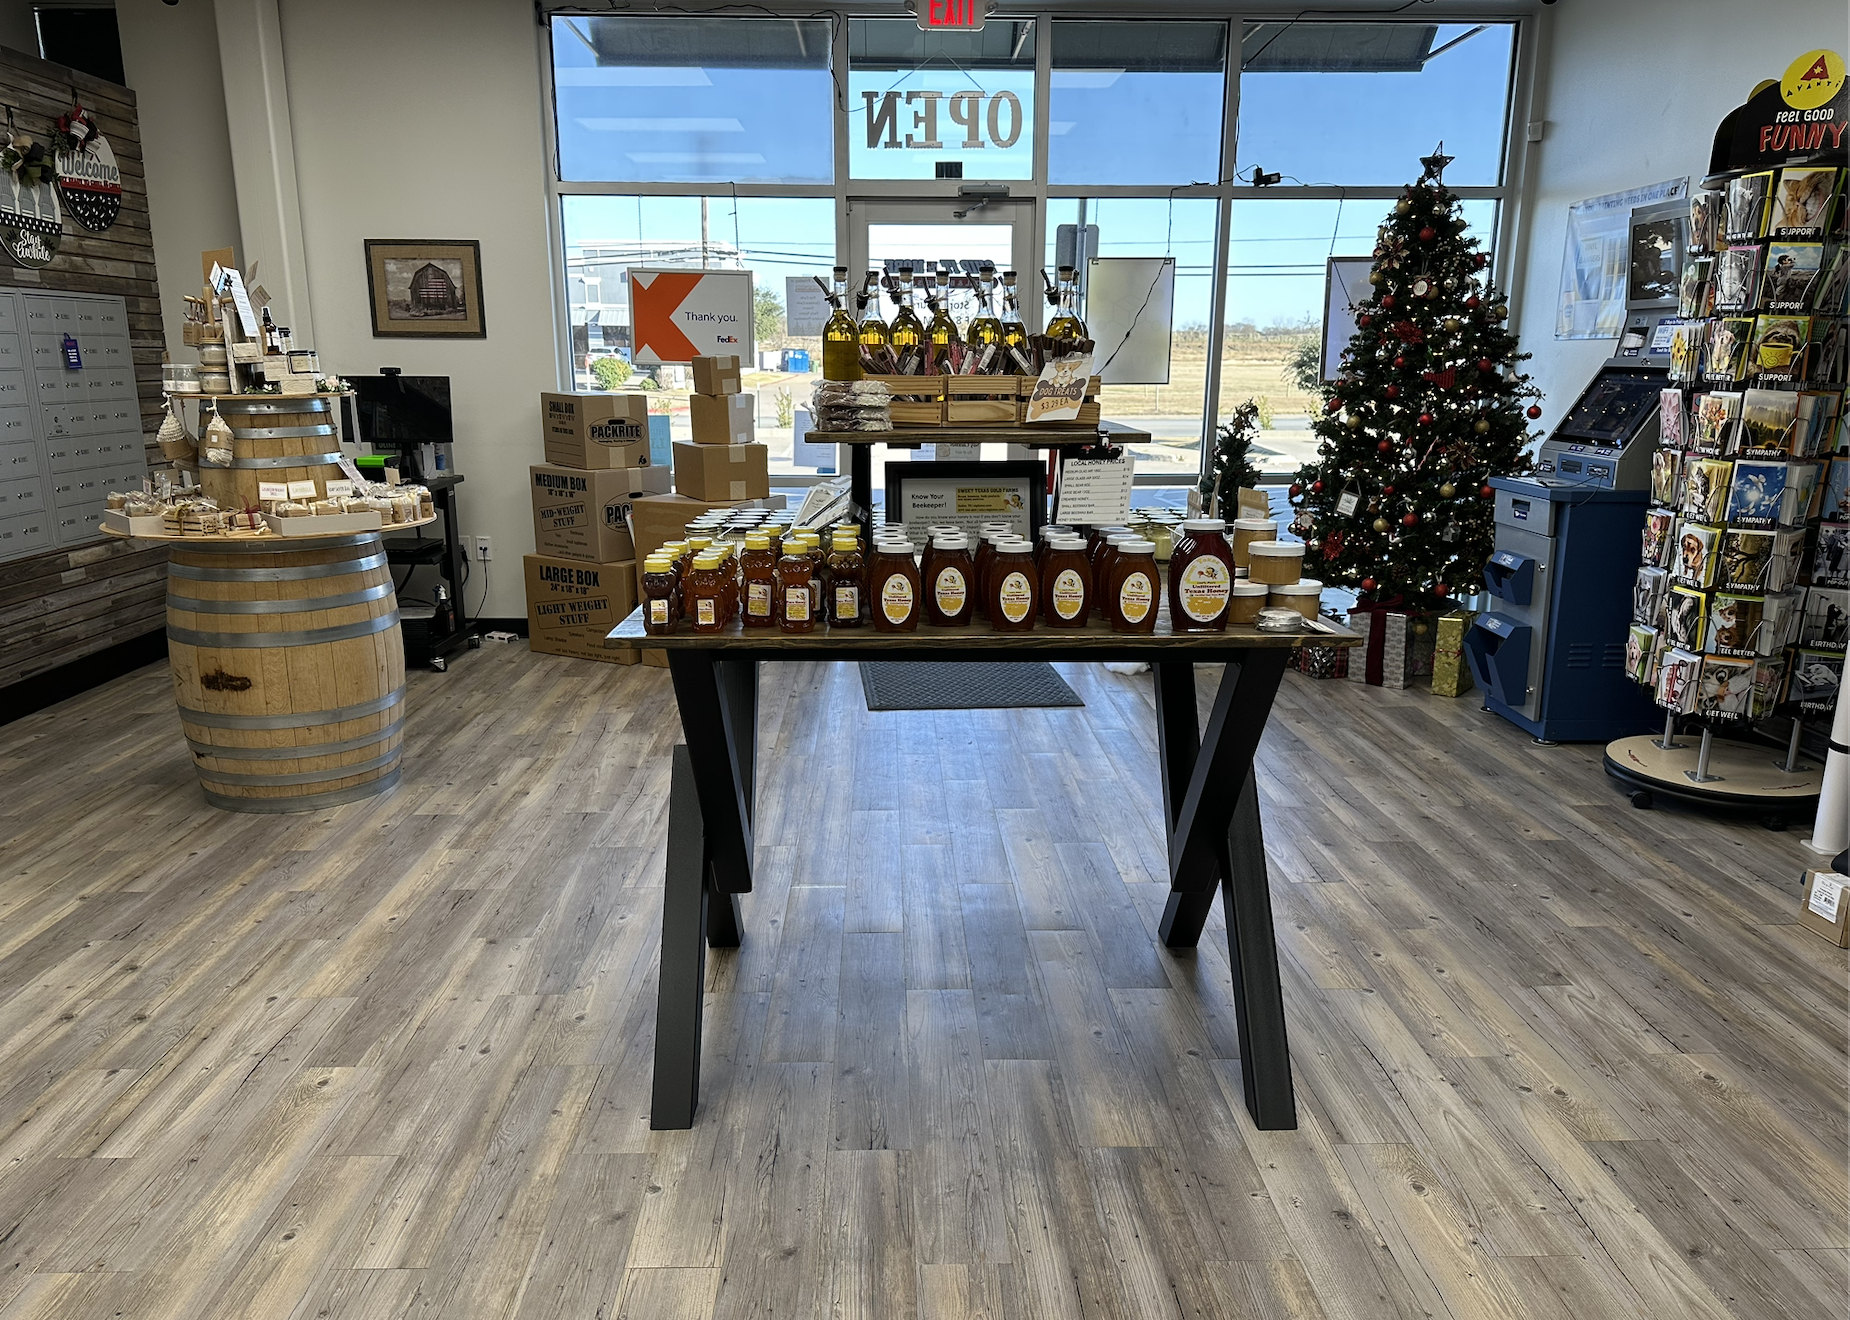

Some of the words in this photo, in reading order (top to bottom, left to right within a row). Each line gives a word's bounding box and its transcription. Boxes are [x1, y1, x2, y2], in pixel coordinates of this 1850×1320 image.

[929, 0, 974, 26] EXIT
[1786, 80, 1841, 97] AVANTI
[1804, 108, 1834, 122] GOOD
[1759, 121, 1848, 152] FUNNY
[61, 156, 119, 181] Welcome
[1641, 193, 1647, 202] IN
[1648, 190, 1659, 201] ONE
[1780, 227, 1816, 237] SUPPORT
[20, 229, 41, 250] Stay
[12, 241, 51, 262] Awhile
[1769, 301, 1805, 310] SUPPORT
[685, 312, 716, 322] Thank
[717, 313, 738, 324] you.
[717, 336, 738, 344] FedEx
[1758, 373, 1793, 382] SUPPORT
[1039, 388, 1054, 396] DOG
[1054, 388, 1078, 396] TREATS
[1060, 397, 1069, 406] EA
[549, 401, 565, 414] SMALL
[565, 403, 575, 415] BOX
[591, 425, 641, 439] PACKRITE
[1746, 449, 1781, 457] SYMPATHY
[535, 473, 569, 490] MEDIUM
[570, 476, 587, 492] BOX
[540, 504, 585, 519] MID-WEIGHT
[553, 516, 576, 528] STUFF
[1737, 517, 1772, 525] SYMPATHY
[539, 565, 574, 584] LARGE
[576, 569, 600, 587] BOX
[550, 583, 560, 592] 24"
[565, 585, 575, 594] 18"
[1725, 582, 1760, 591] SYMPATHY
[537, 602, 566, 616] LIGHT
[568, 599, 608, 612] WEIGHT
[559, 612, 590, 626] STUFF
[1810, 640, 1846, 649] BIRTHDAY
[1732, 648, 1755, 657] BETTER
[1705, 710, 1720, 718] GET
[1721, 711, 1738, 720] WELL
